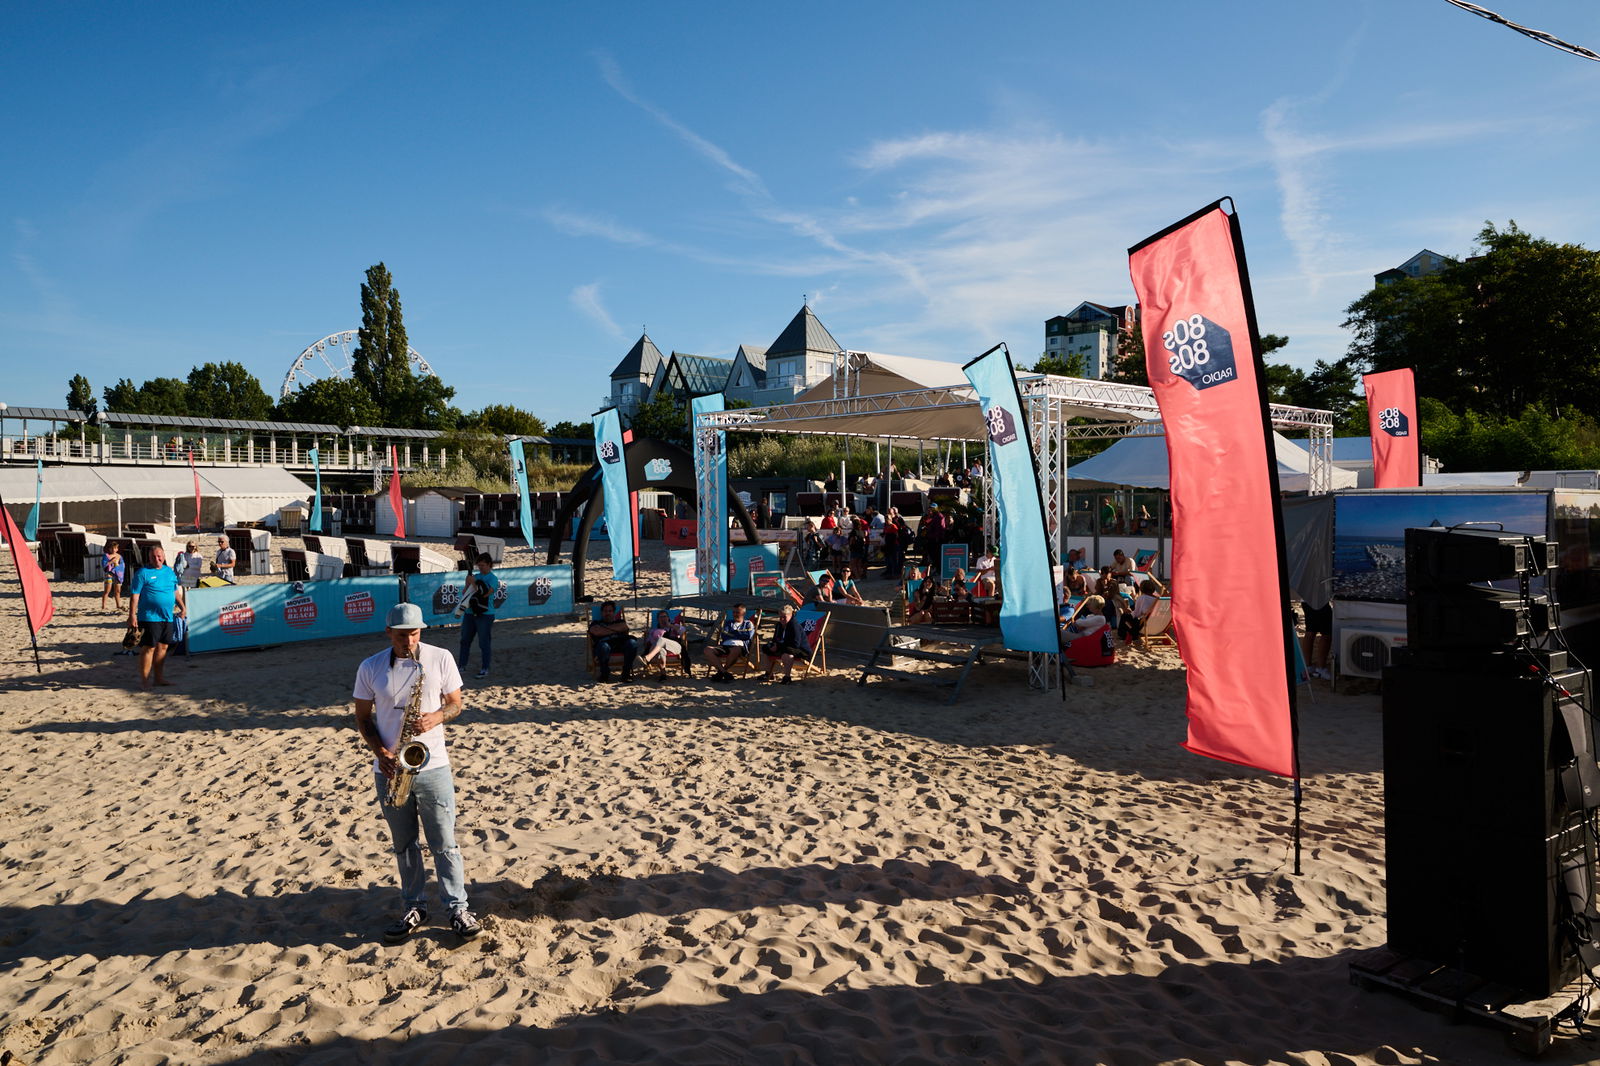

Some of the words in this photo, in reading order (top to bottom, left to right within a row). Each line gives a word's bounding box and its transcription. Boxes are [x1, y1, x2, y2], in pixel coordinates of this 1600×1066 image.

[653, 465, 673, 473] 80s
[535, 577, 553, 587] 80s
[441, 583, 460, 594] 80s
[536, 586, 553, 596] 80s
[346, 592, 369, 601] MOVIES
[441, 594, 461, 604] 80s
[286, 597, 311, 606] MOVIES
[221, 602, 248, 612] MOVIES
[347, 606, 373, 614] BEACH
[287, 611, 315, 619] BEACH
[222, 618, 252, 626] BEACH
